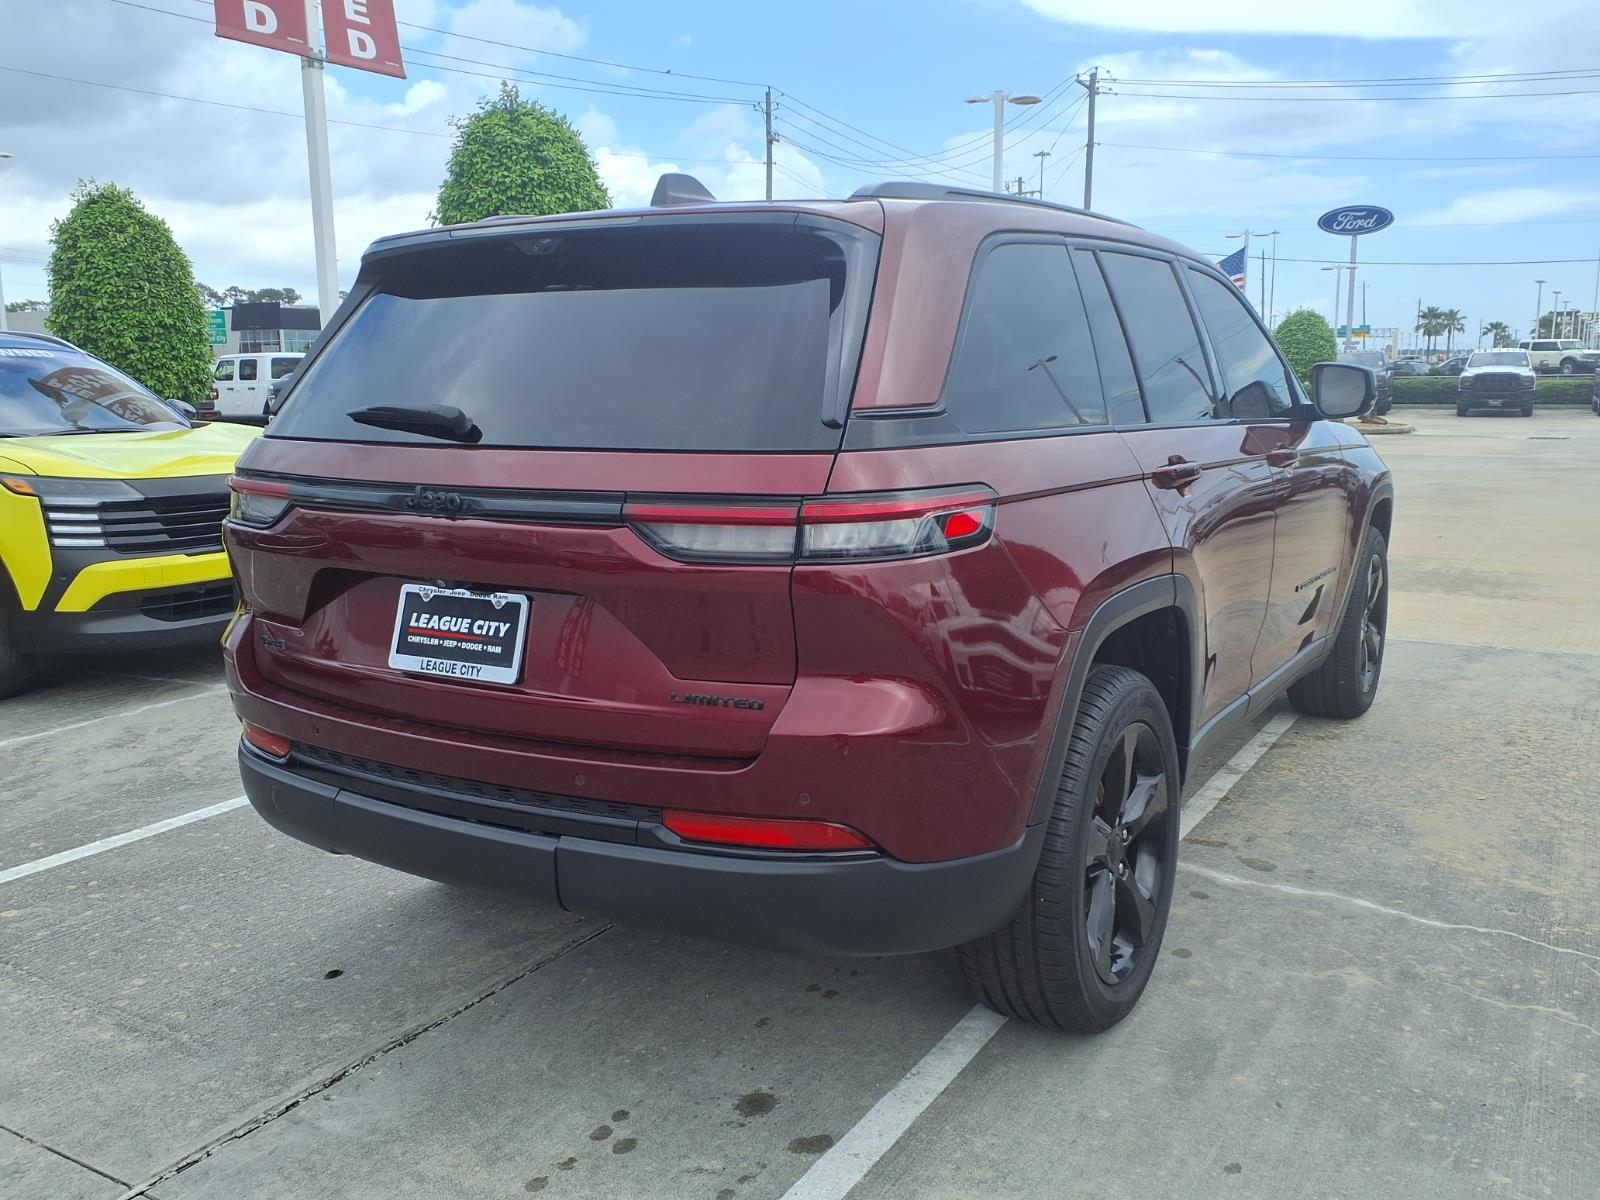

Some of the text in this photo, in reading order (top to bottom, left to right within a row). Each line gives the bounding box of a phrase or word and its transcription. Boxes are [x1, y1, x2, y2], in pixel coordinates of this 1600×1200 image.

[1333, 211, 1378, 230] Ford
[407, 485, 461, 512] Jeep
[418, 586, 446, 595] Chrysler
[409, 612, 511, 637] LEAGUE CITY
[407, 635, 502, 653] CHRYSLER JEEP DODGE RAM
[420, 659, 482, 677] LEAGUE CITY
[671, 692, 764, 710] LIMITED
